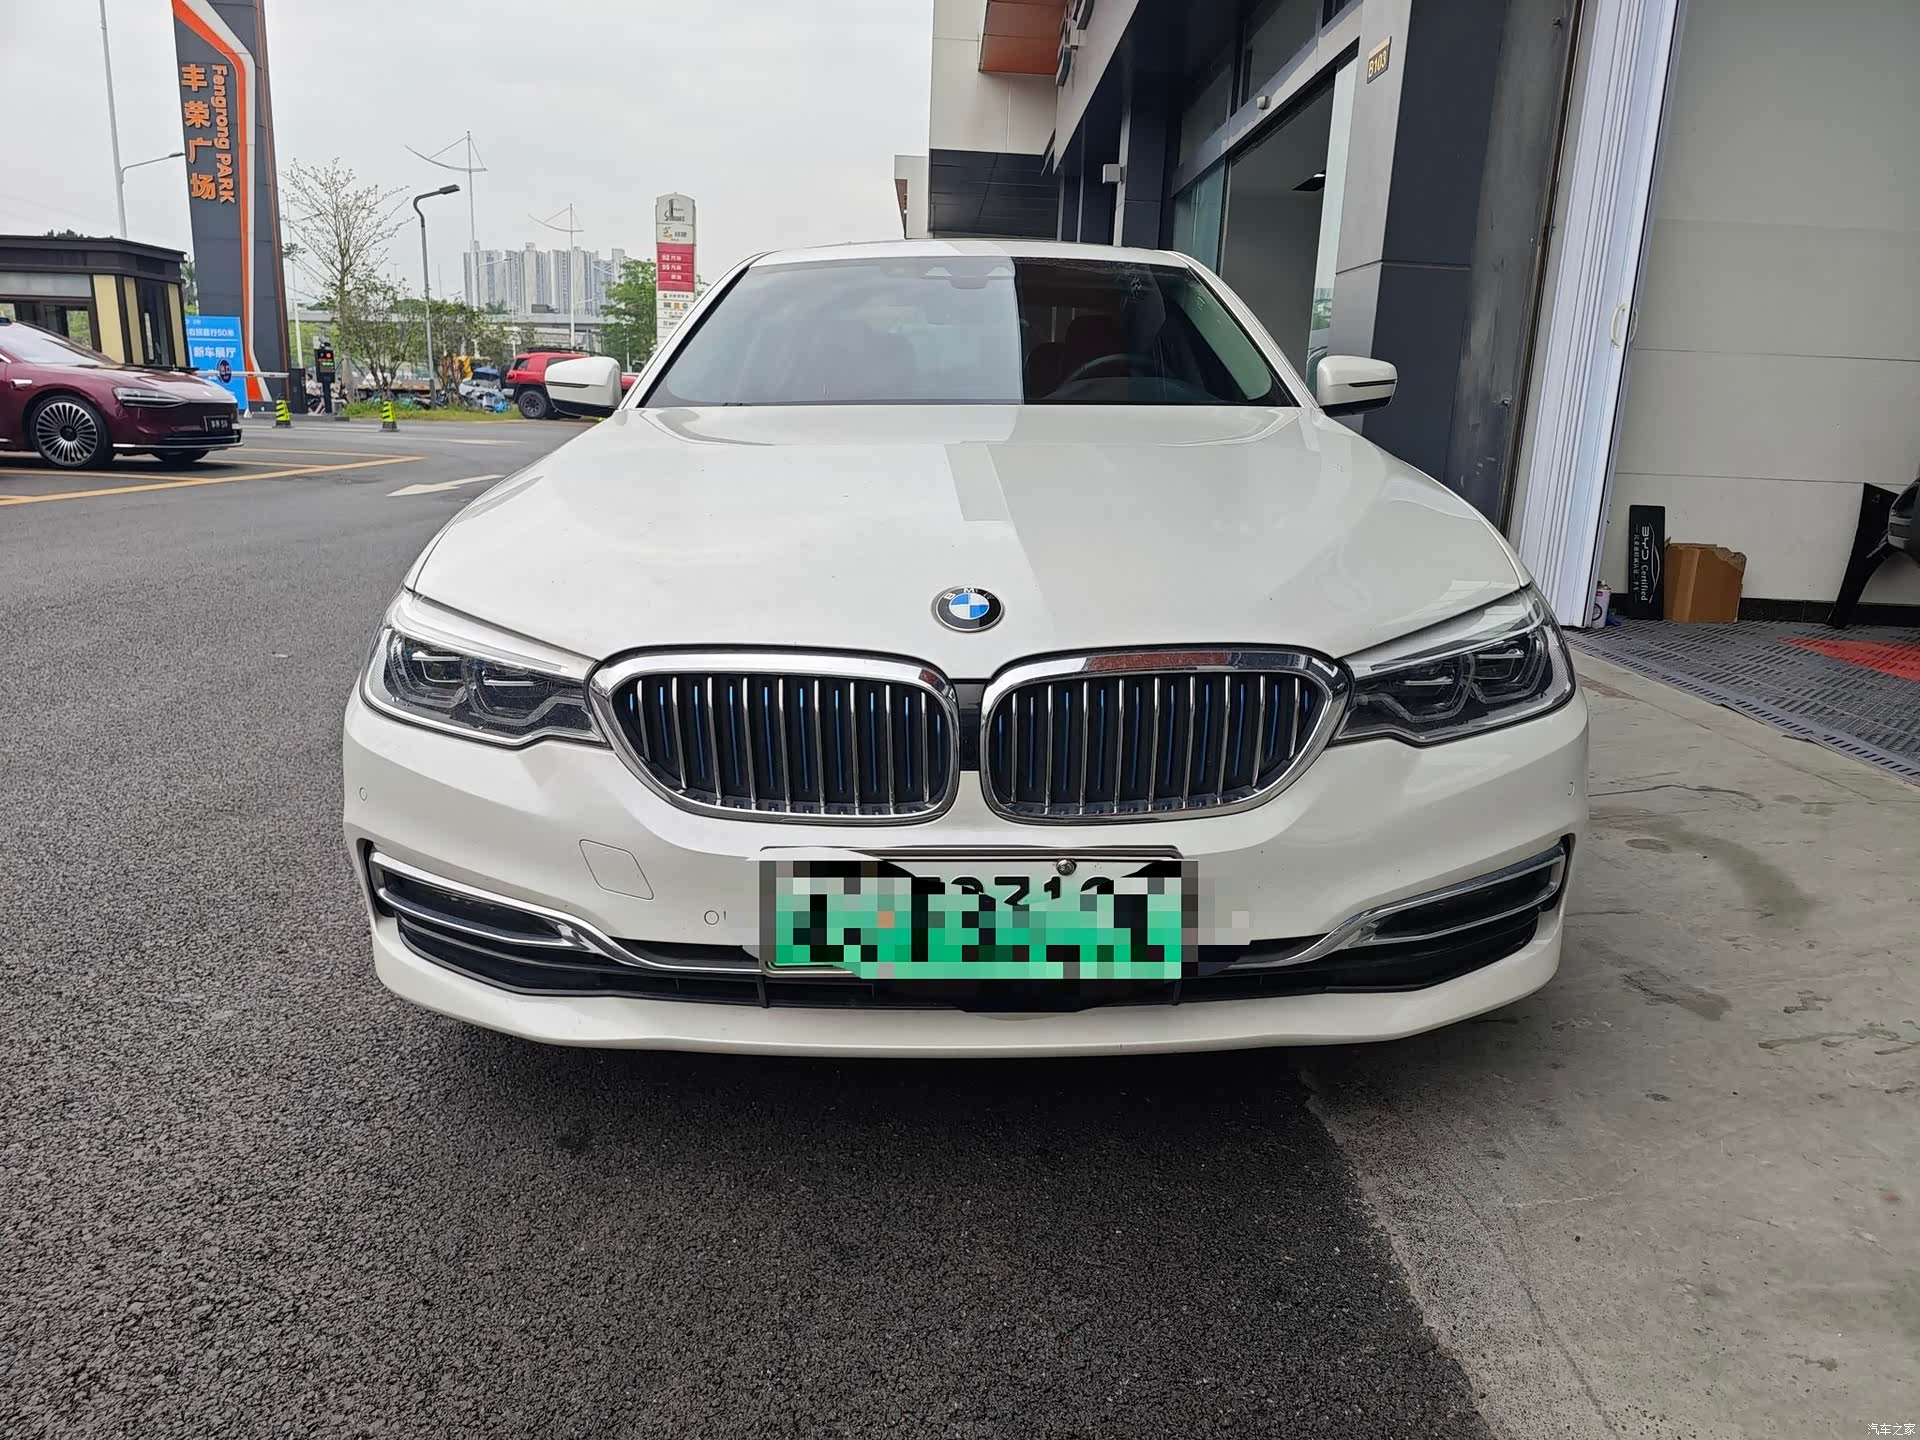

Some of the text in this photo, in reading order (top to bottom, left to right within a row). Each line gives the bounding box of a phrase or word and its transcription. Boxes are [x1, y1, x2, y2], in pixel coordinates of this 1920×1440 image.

[1368, 50, 1387, 78] B103
[181, 63, 217, 200] 丰荣广场
[211, 65, 236, 204] Fengrong PARK
[193, 346, 236, 358] 新车展厅
[1640, 525, 1650, 601] BYD Certified
